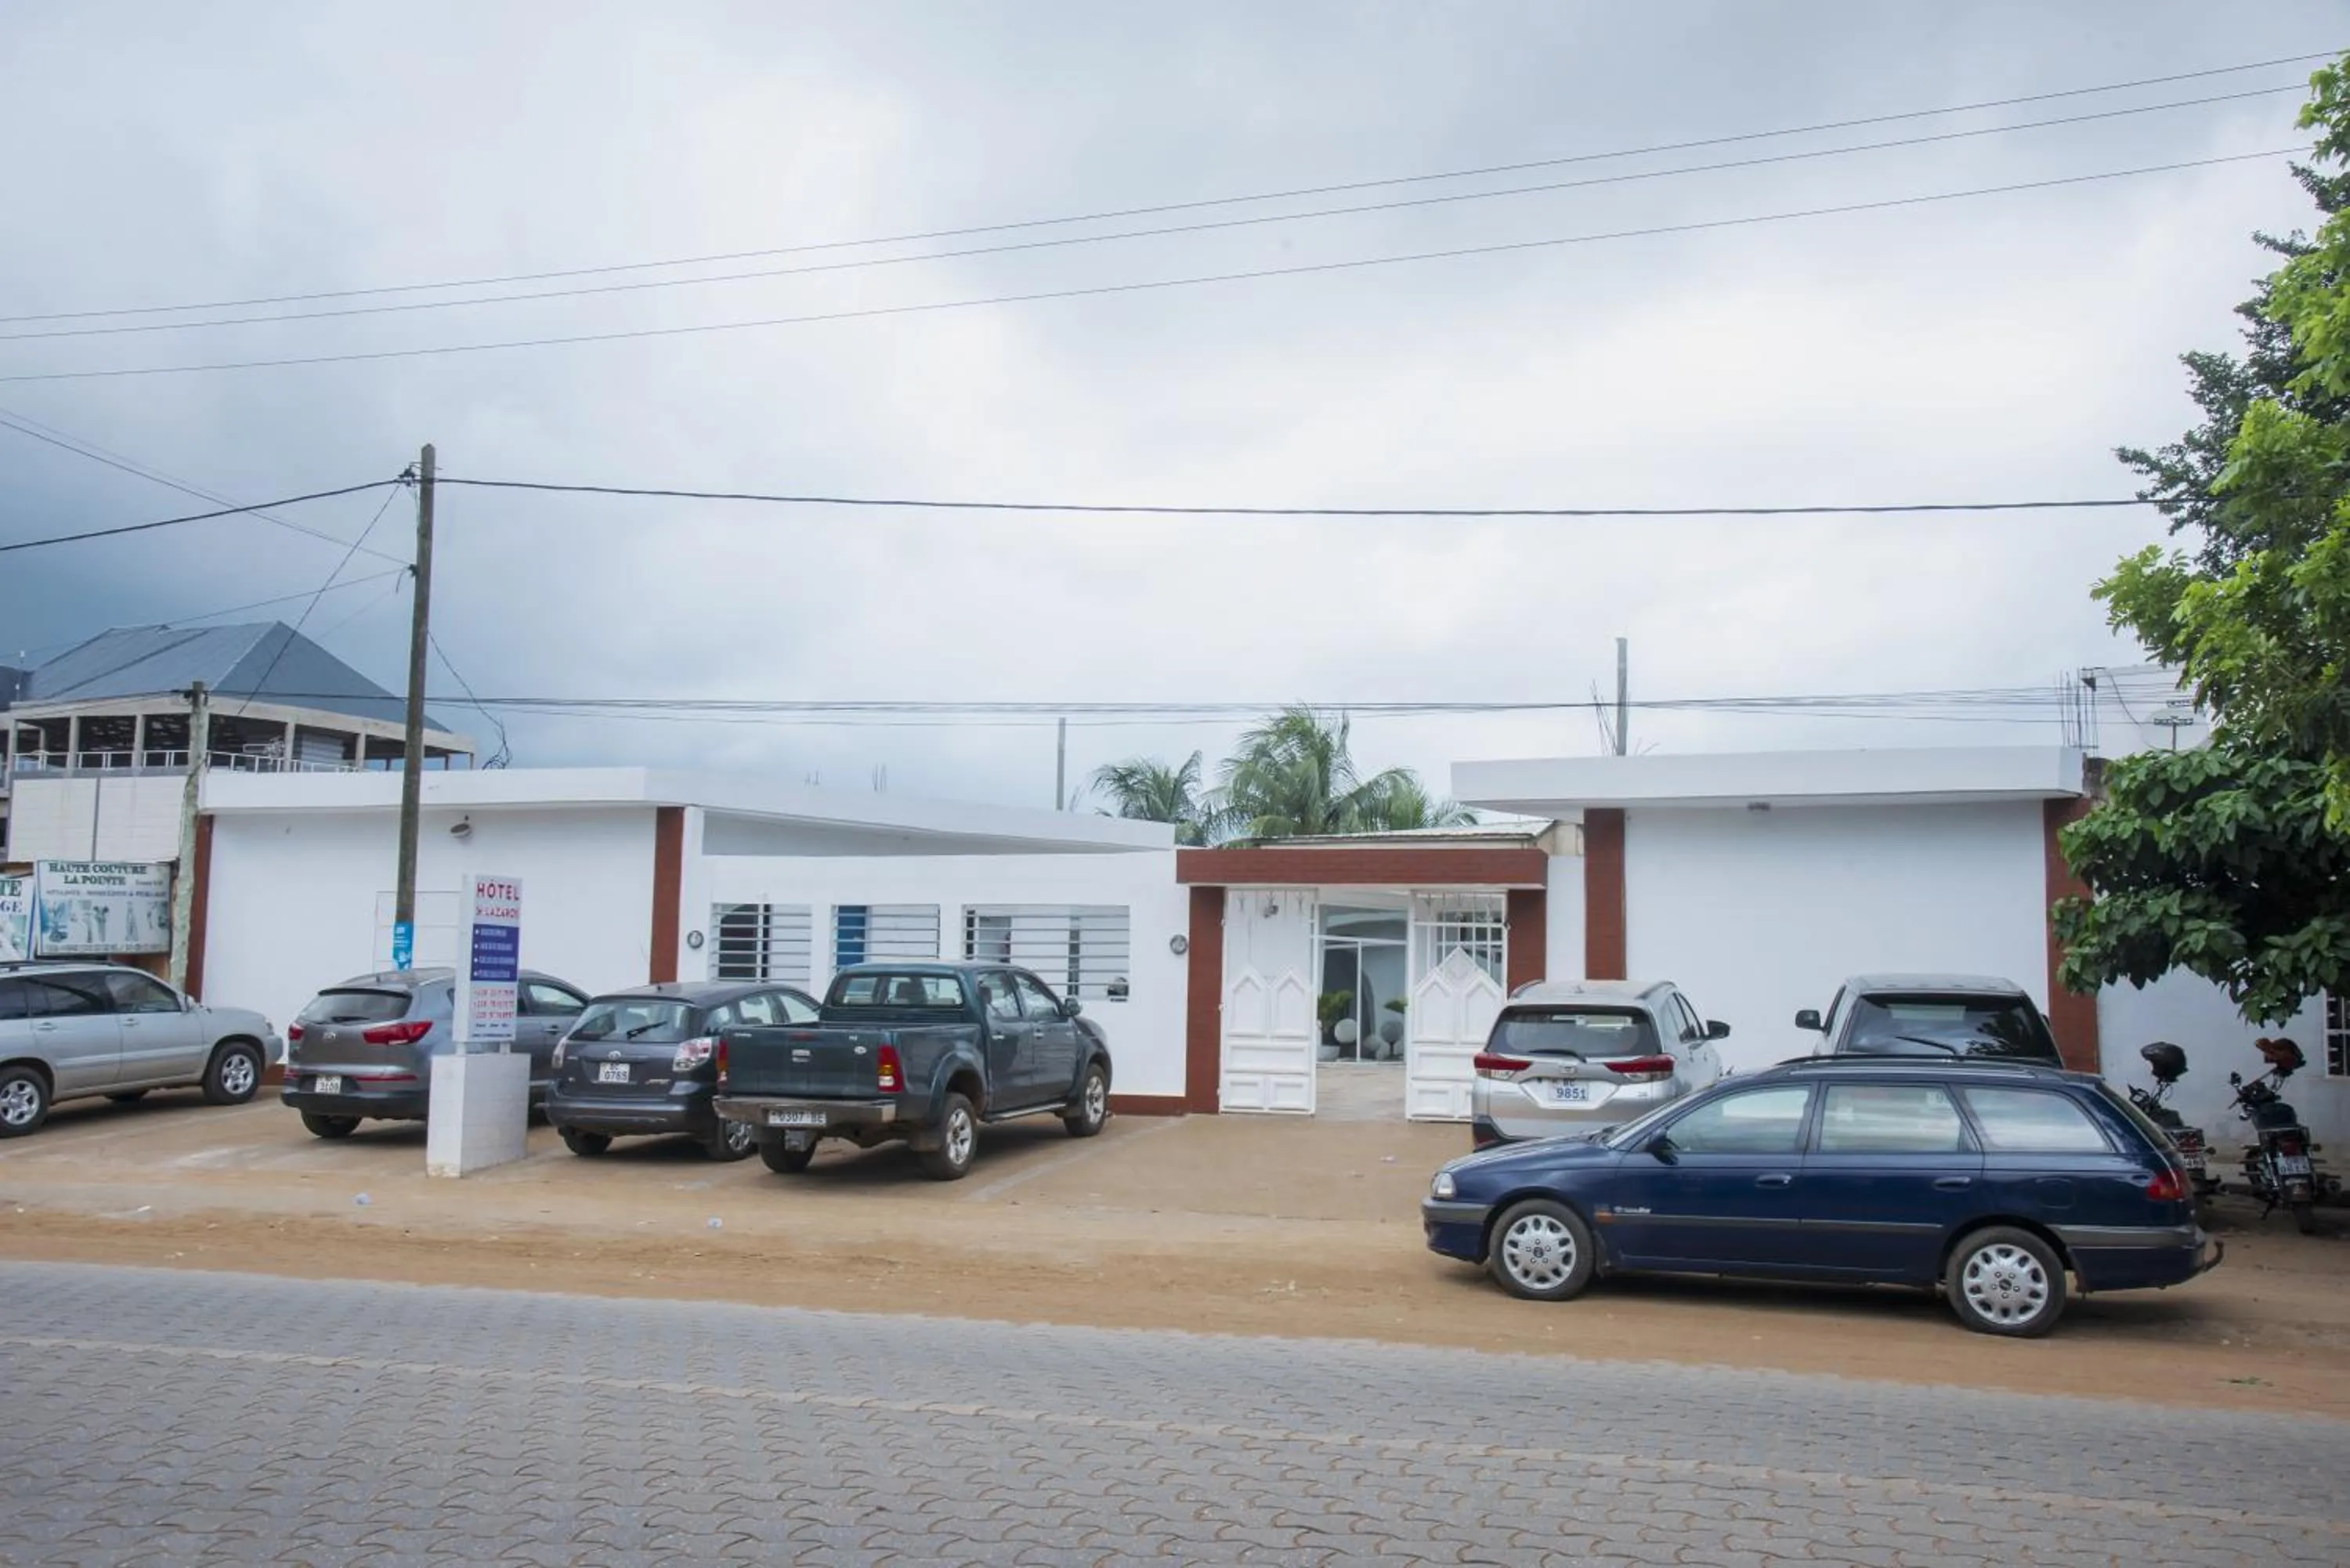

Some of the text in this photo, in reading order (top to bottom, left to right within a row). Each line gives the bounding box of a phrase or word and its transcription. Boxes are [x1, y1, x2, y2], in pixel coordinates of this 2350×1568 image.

[49, 863, 147, 874] HAUTE COUTURE
[81, 876, 126, 885] POINTE
[1556, 1088, 1585, 1100] 9851
